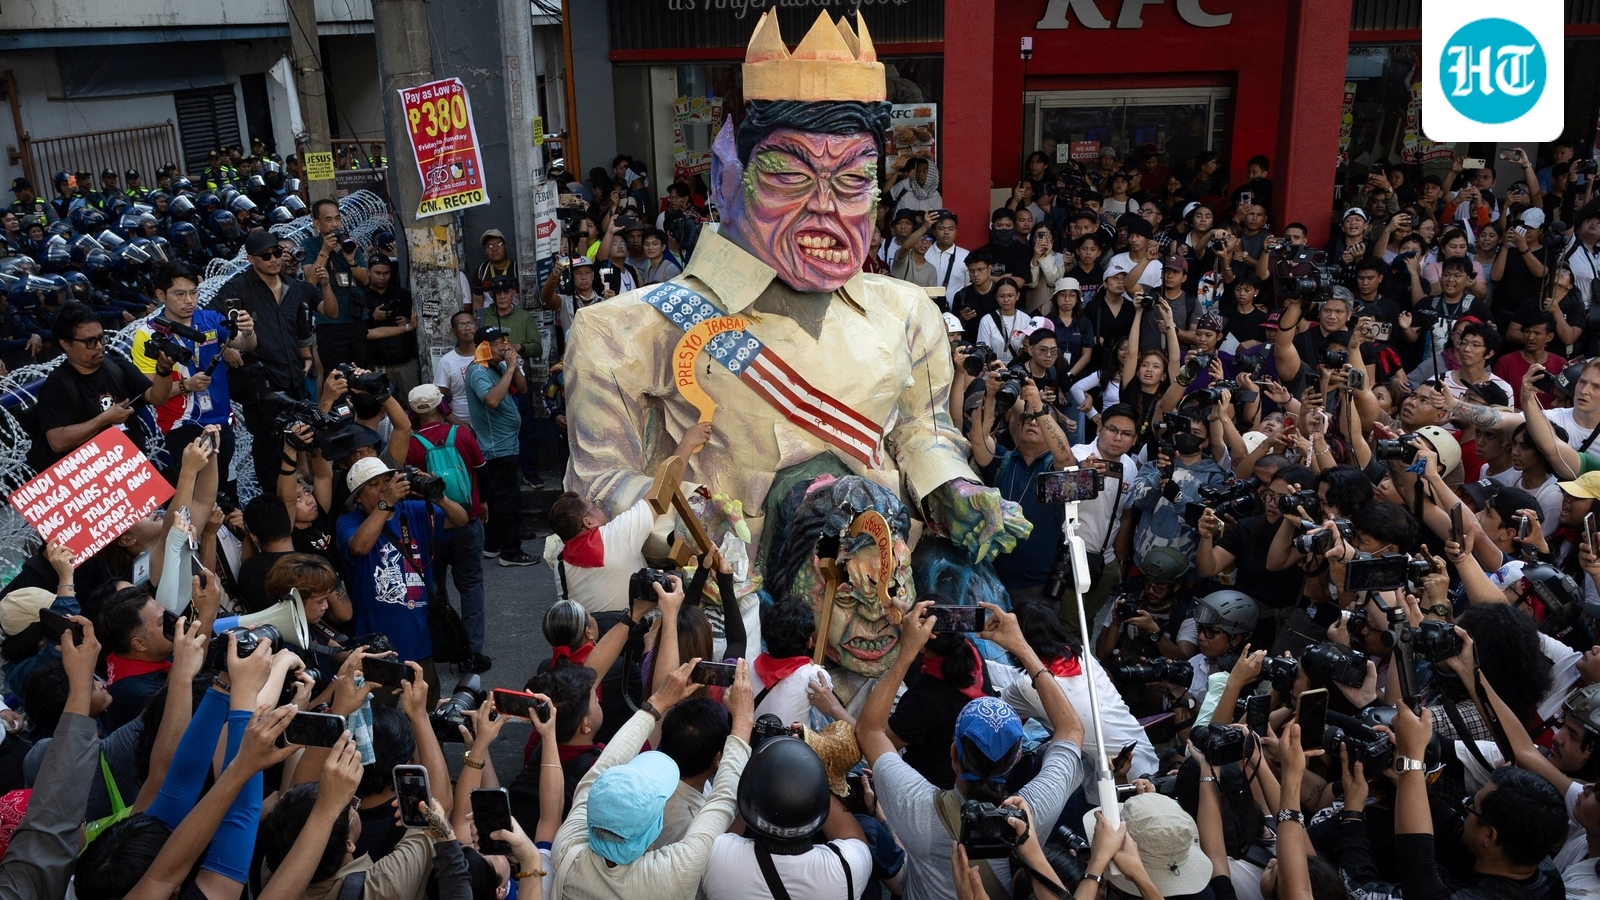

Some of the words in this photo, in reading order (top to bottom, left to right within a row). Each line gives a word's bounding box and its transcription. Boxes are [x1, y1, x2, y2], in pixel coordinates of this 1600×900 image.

[404, 92, 420, 105] Pay
[422, 90, 433, 100] as
[433, 83, 450, 97] Low
[451, 83, 461, 93] as
[890, 109, 912, 119] KFC
[307, 154, 332, 164] JESUS
[418, 142, 438, 152] Friday
[1432, 151, 1451, 159] HOLIDAY
[443, 191, 482, 210] RECTO
[678, 333, 702, 387] PRESYO
[704, 317, 745, 336] IBABA!
[12, 473, 54, 510] HINDI
[53, 442, 101, 481] NAMAN
[23, 484, 72, 522] TALAGA
[69, 445, 124, 490] MAHIRAP
[36, 511, 65, 540] ANG
[63, 483, 109, 518] PINAS.
[104, 450, 148, 487] MARAMI
[82, 488, 128, 523] TALAGA
[126, 467, 152, 492] ANG
[88, 498, 135, 540] KORAP!
[114, 495, 158, 537] PARTYLIST
[756, 815, 822, 837] PRESS
